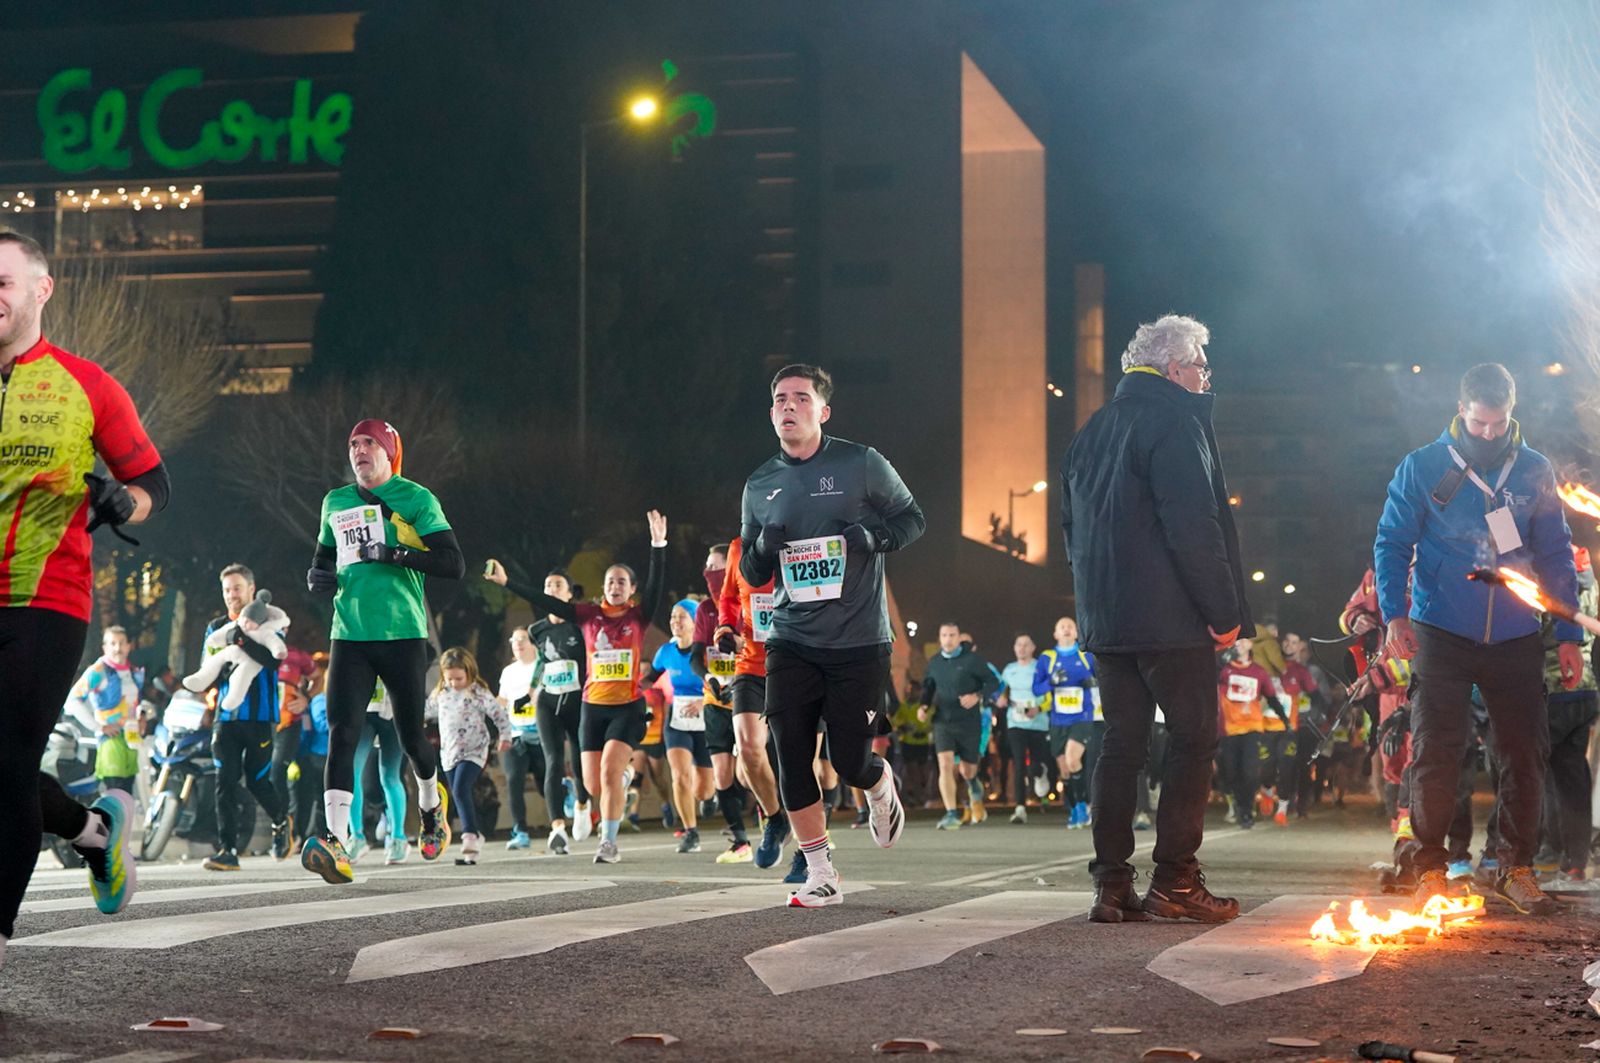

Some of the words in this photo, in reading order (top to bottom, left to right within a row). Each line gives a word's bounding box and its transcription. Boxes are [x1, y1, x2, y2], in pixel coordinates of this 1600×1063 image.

[37, 67, 132, 173] El
[138, 67, 354, 169] Corte
[343, 525, 373, 546] 7031
[793, 545, 813, 554] NOCHE
[812, 544, 821, 552] DE
[787, 554, 800, 563] SAN
[789, 558, 842, 582] 12382
[599, 662, 625, 676] 3919
